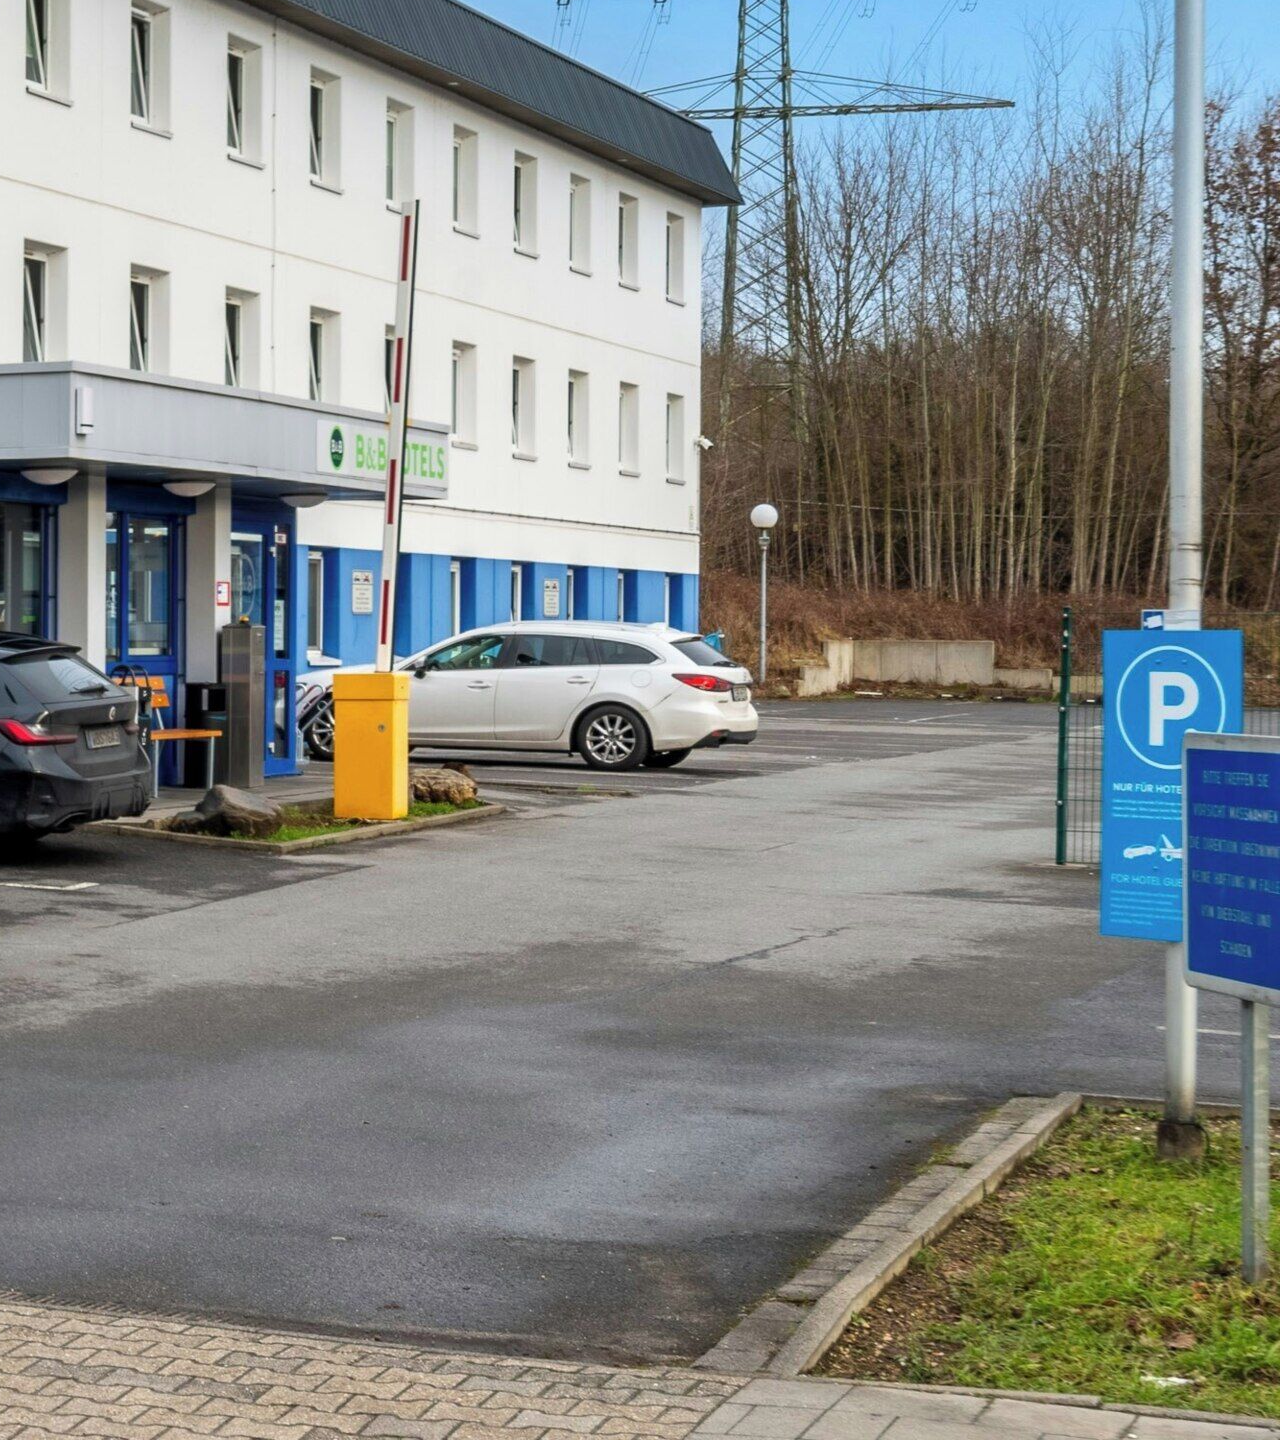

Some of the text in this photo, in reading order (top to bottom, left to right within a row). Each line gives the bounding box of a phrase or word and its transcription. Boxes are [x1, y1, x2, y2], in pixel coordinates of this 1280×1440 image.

[355, 434, 445, 480] B&B OTELS
[1148, 671, 1199, 747] P
[1112, 782, 1182, 794] NUR FÜR HOTE
[1256, 773, 1269, 788] SIE
[1110, 873, 1183, 888] FOR HOTEL GUE
